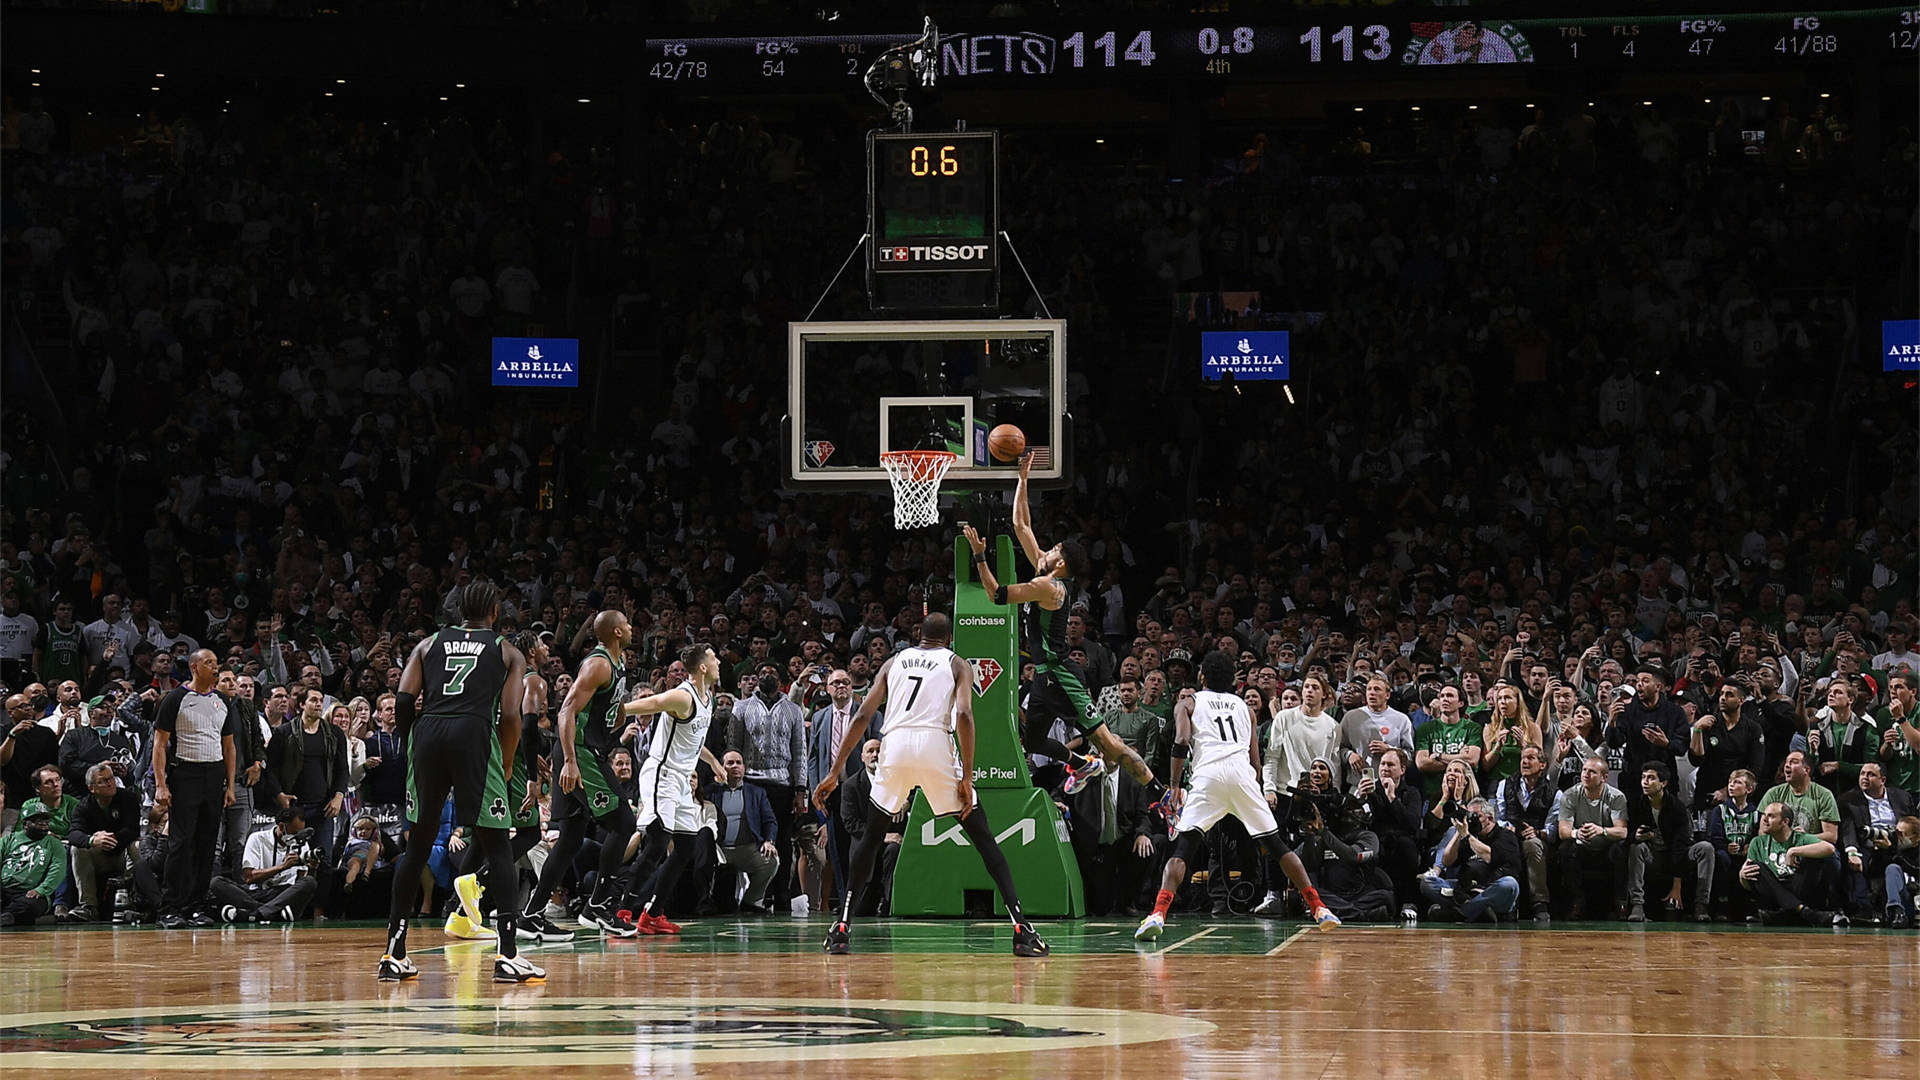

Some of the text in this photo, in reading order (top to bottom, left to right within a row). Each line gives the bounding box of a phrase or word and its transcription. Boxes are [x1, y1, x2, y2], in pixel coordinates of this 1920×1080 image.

[1559, 26, 1587, 38] TOL
[1613, 25, 1640, 37] FLS
[1680, 19, 1727, 34] FG%
[1793, 17, 1821, 31] FG
[755, 42, 799, 55] FG%
[1063, 30, 1156, 67] 114
[1198, 27, 1254, 54] 0.8
[1300, 24, 1392, 62] 113
[1623, 40, 1635, 57] 4
[1689, 38, 1714, 56] 47
[1774, 35, 1838, 56] 41/88
[663, 44, 688, 56] FG
[839, 43, 865, 56] TOL
[942, 35, 1048, 76] NETS
[1570, 42, 1578, 58] 1
[650, 61, 708, 80] 42/78
[762, 60, 785, 76] 54
[847, 58, 858, 75] 2
[1205, 59, 1231, 74] 4th
[911, 145, 958, 176] 0.6
[909, 245, 989, 261] TISSOT
[497, 361, 574, 372] ARBELLA
[1207, 354, 1284, 366] ARBELLA
[958, 616, 1006, 626] coinbase
[443, 640, 487, 656] BROWN
[901, 658, 939, 671] DURANT
[442, 655, 478, 695] 7
[905, 675, 923, 711] 7
[1207, 700, 1237, 711] IRVING
[1213, 715, 1238, 743] 11
[971, 767, 1017, 782] gle Pixel
